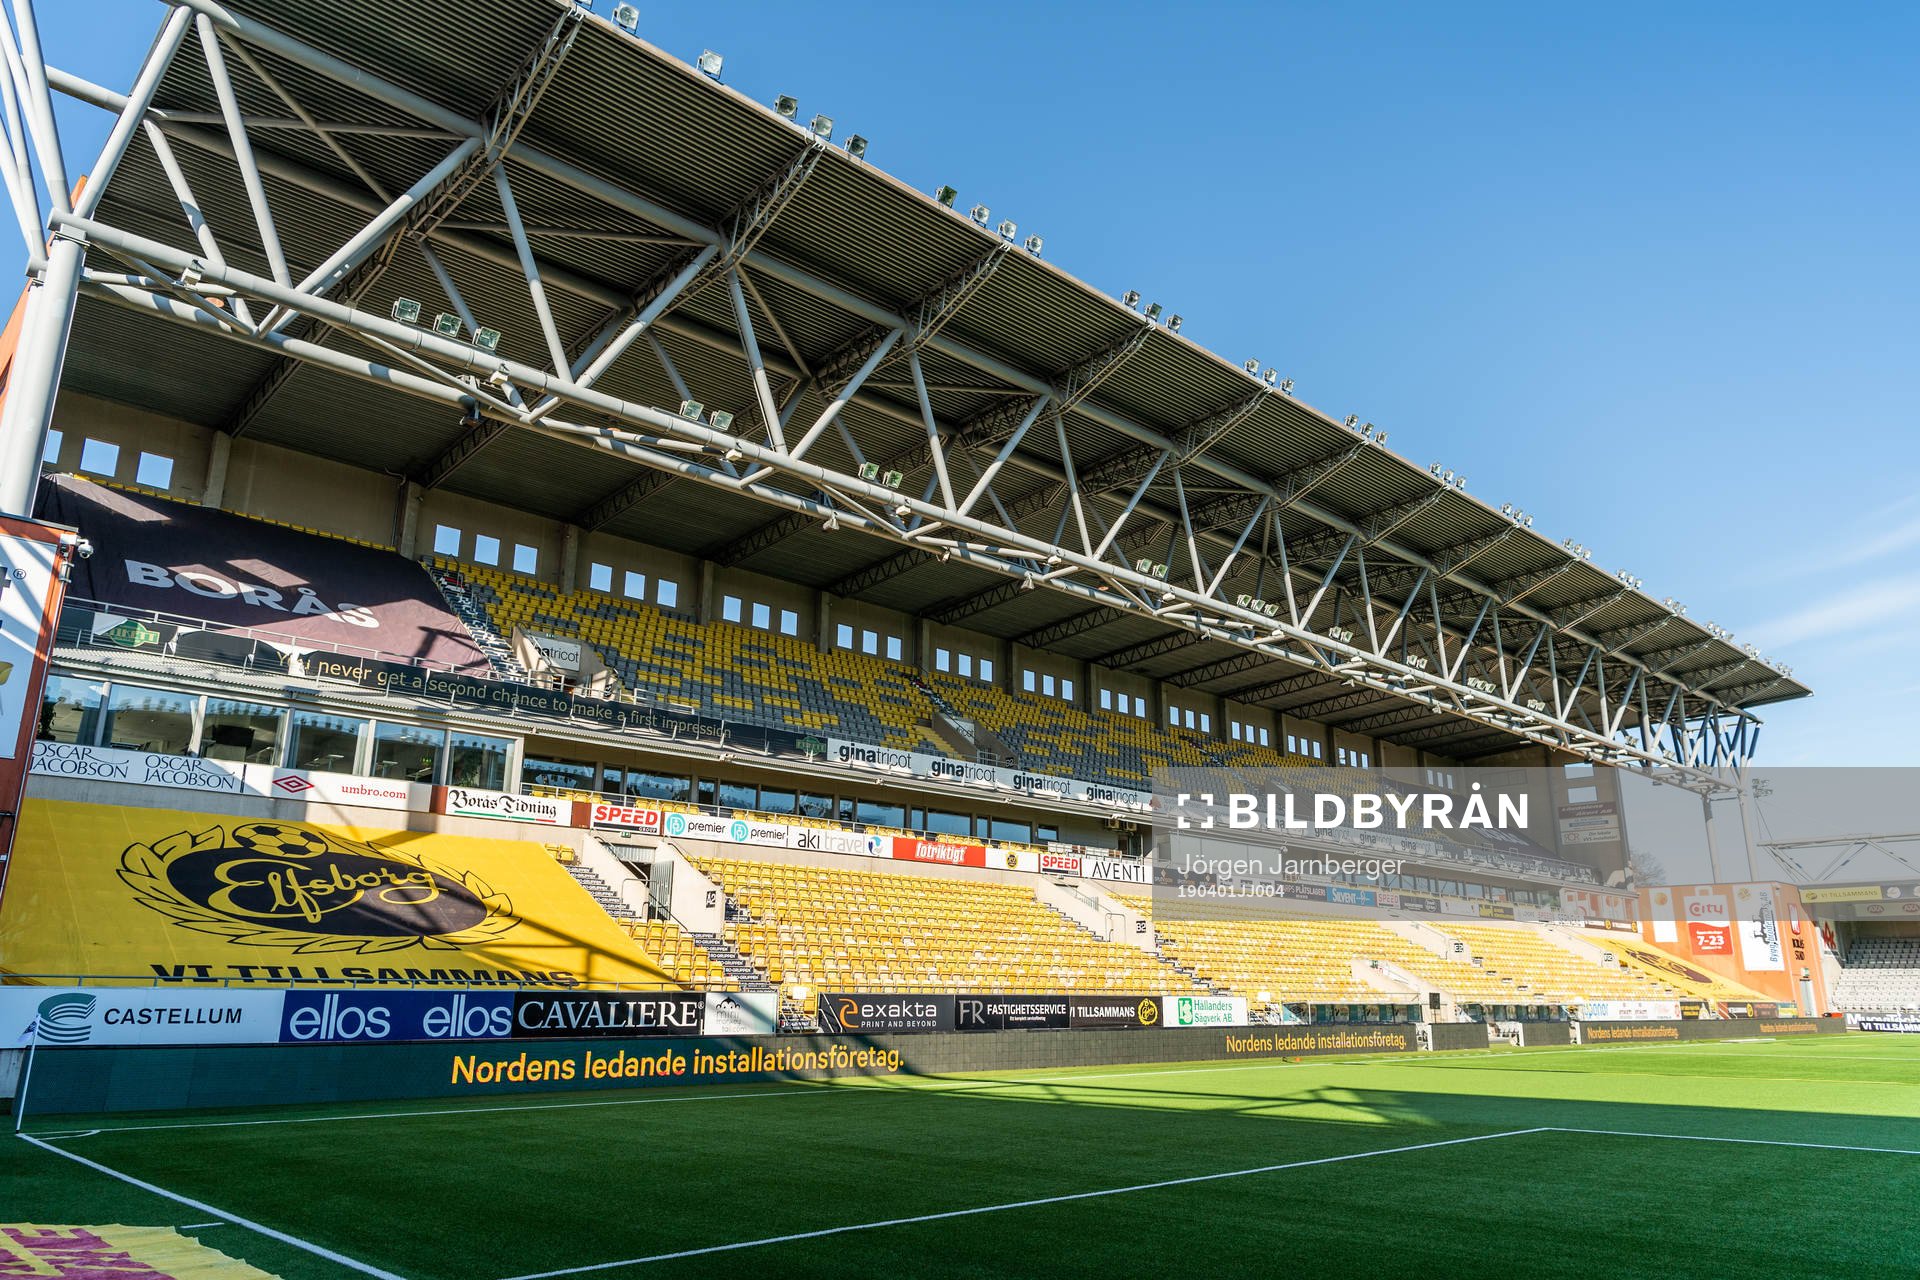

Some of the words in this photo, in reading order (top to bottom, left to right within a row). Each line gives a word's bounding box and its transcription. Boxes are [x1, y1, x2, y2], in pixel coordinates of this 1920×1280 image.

[124, 559, 380, 629] BORÅS
[276, 651, 311, 671] Yu
[320, 661, 372, 681] never
[377, 670, 406, 687] get
[413, 676, 422, 689] a
[428, 678, 486, 700] second
[492, 687, 548, 709] chance
[552, 696, 568, 712] to
[573, 703, 613, 720] make
[617, 711, 626, 721] a
[631, 711, 658, 727] first
[662, 715, 732, 739] impression
[33, 741, 112, 764] OSCAR
[839, 743, 912, 769] ginatricot
[29, 759, 129, 779] JACOBSON
[145, 754, 220, 774] OSCAR
[931, 758, 996, 782] ginatricot
[144, 770, 236, 790] JACOBSON
[1013, 772, 1071, 795] ginatricot
[341, 784, 406, 800] umbro.com
[1086, 784, 1138, 806] ginatricot
[449, 789, 498, 809] Borås
[499, 791, 557, 817] Tidning
[594, 805, 658, 826] SPEED
[687, 821, 726, 834] premier
[750, 828, 786, 840] premier
[797, 829, 821, 849] aki
[824, 832, 866, 854] travel
[1042, 855, 1079, 870] SPEED
[1092, 861, 1145, 882] AVENTI
[207, 858, 448, 924] Elfsborg
[1378, 893, 1399, 904] SPEED
[1689, 902, 1723, 917] City
[1697, 935, 1725, 946] 7-23
[150, 965, 220, 983] VI
[227, 965, 580, 987] TILLSAMMANS
[104, 1007, 242, 1026] CASTELLUM
[290, 994, 391, 1041] ellos
[422, 994, 511, 1038] ellos
[861, 1002, 937, 1018] exakta
[960, 1000, 985, 1024] FR
[987, 1003, 1066, 1015] FASTIGHETSSERVICE
[1077, 1006, 1135, 1018] TILLSAMMANS
[1861, 1022, 1872, 1030] VI
[1226, 1034, 1273, 1053] Nordens
[1275, 1033, 1316, 1051] ledande
[1317, 1031, 1407, 1049] installationsföretag.
[452, 1053, 576, 1084] Nordens
[584, 1049, 687, 1079] ledande
[693, 1045, 905, 1074] installationsföretag.
